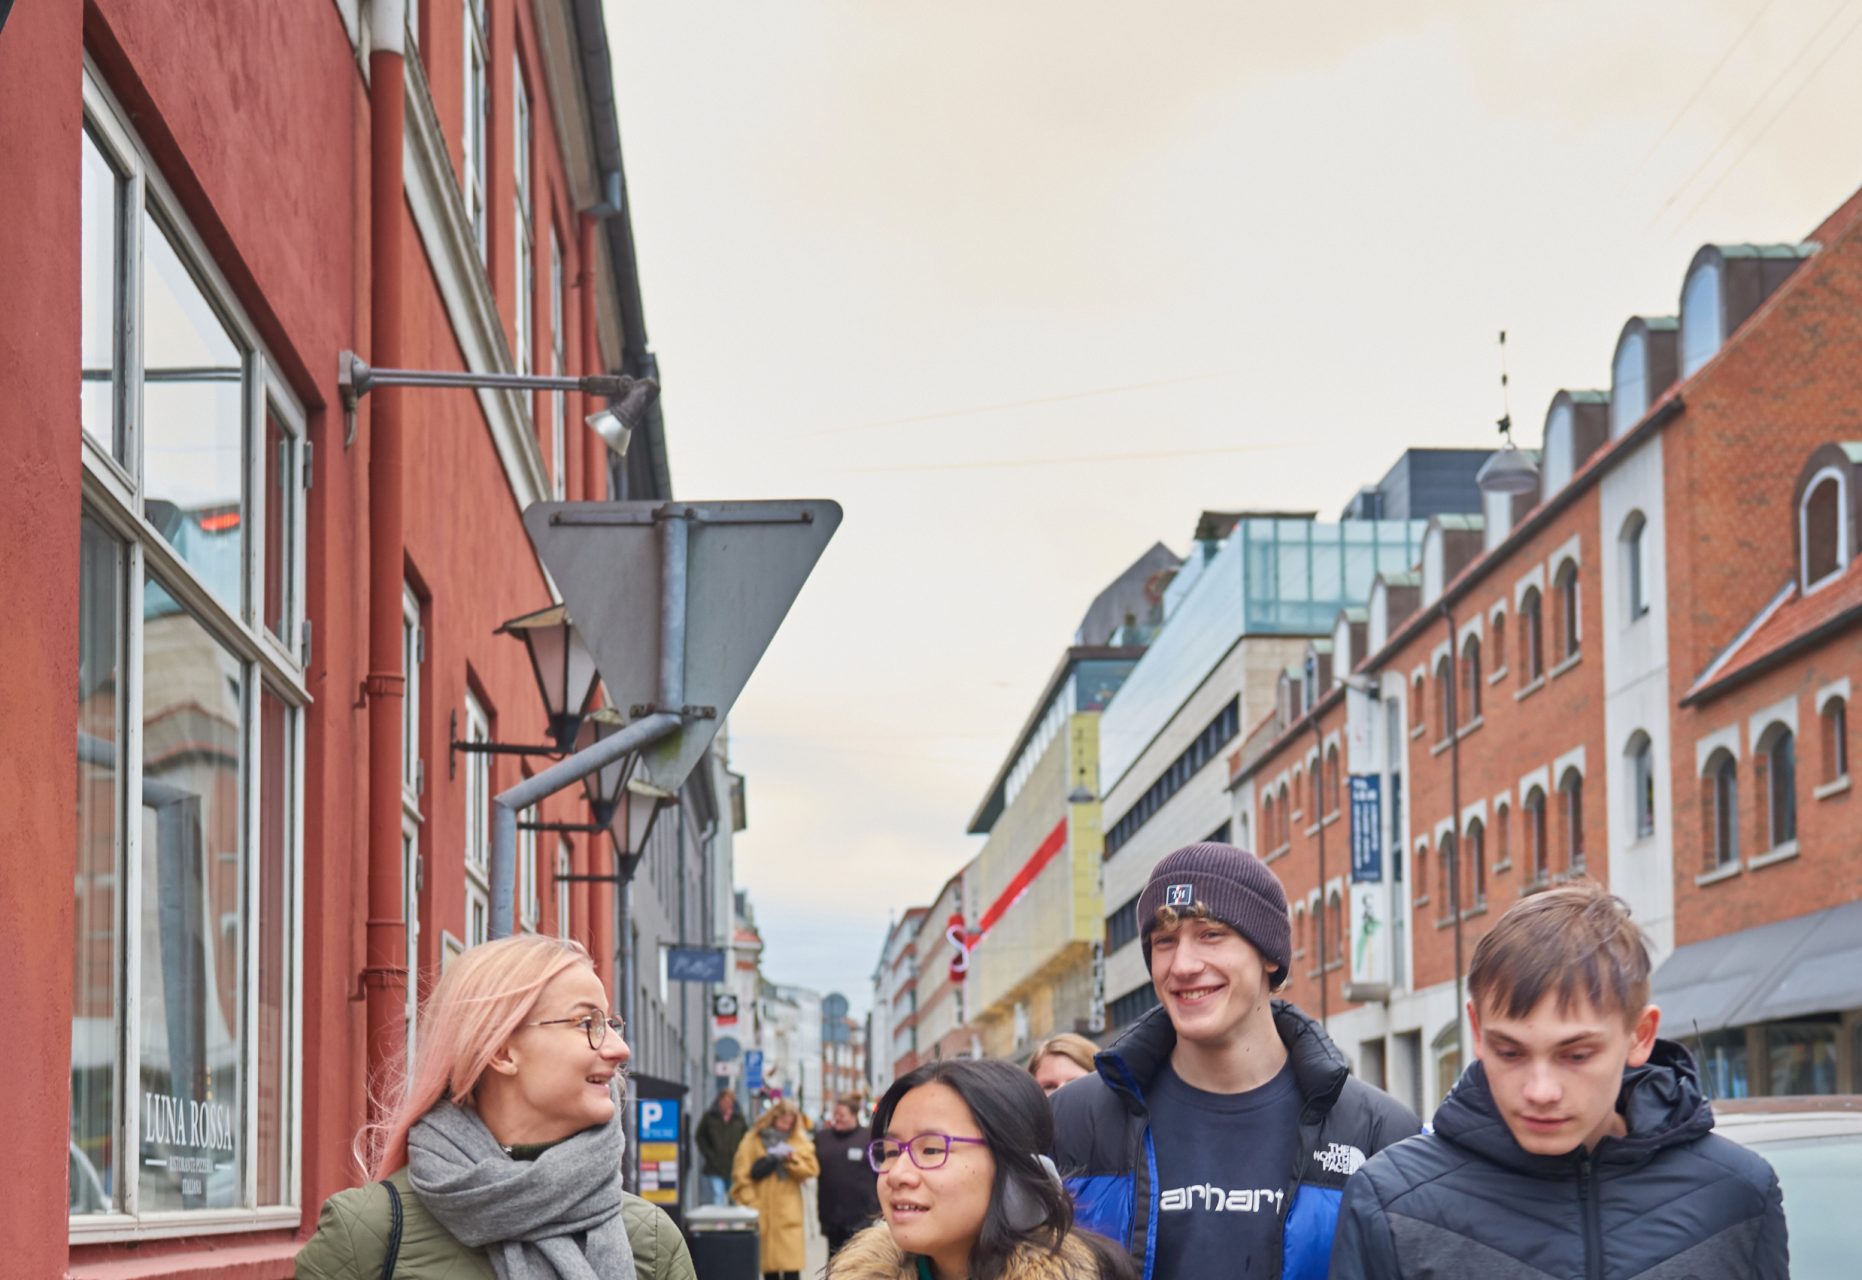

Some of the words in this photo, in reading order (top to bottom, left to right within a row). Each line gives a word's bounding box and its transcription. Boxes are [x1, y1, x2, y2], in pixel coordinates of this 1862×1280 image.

[145, 1092, 187, 1146] LUNA
[189, 1100, 233, 1151] ROSSA
[641, 1101, 662, 1130] P
[1327, 1142, 1350, 1154] THE
[1313, 1150, 1350, 1165] NORTH
[1322, 1161, 1350, 1175] FACE
